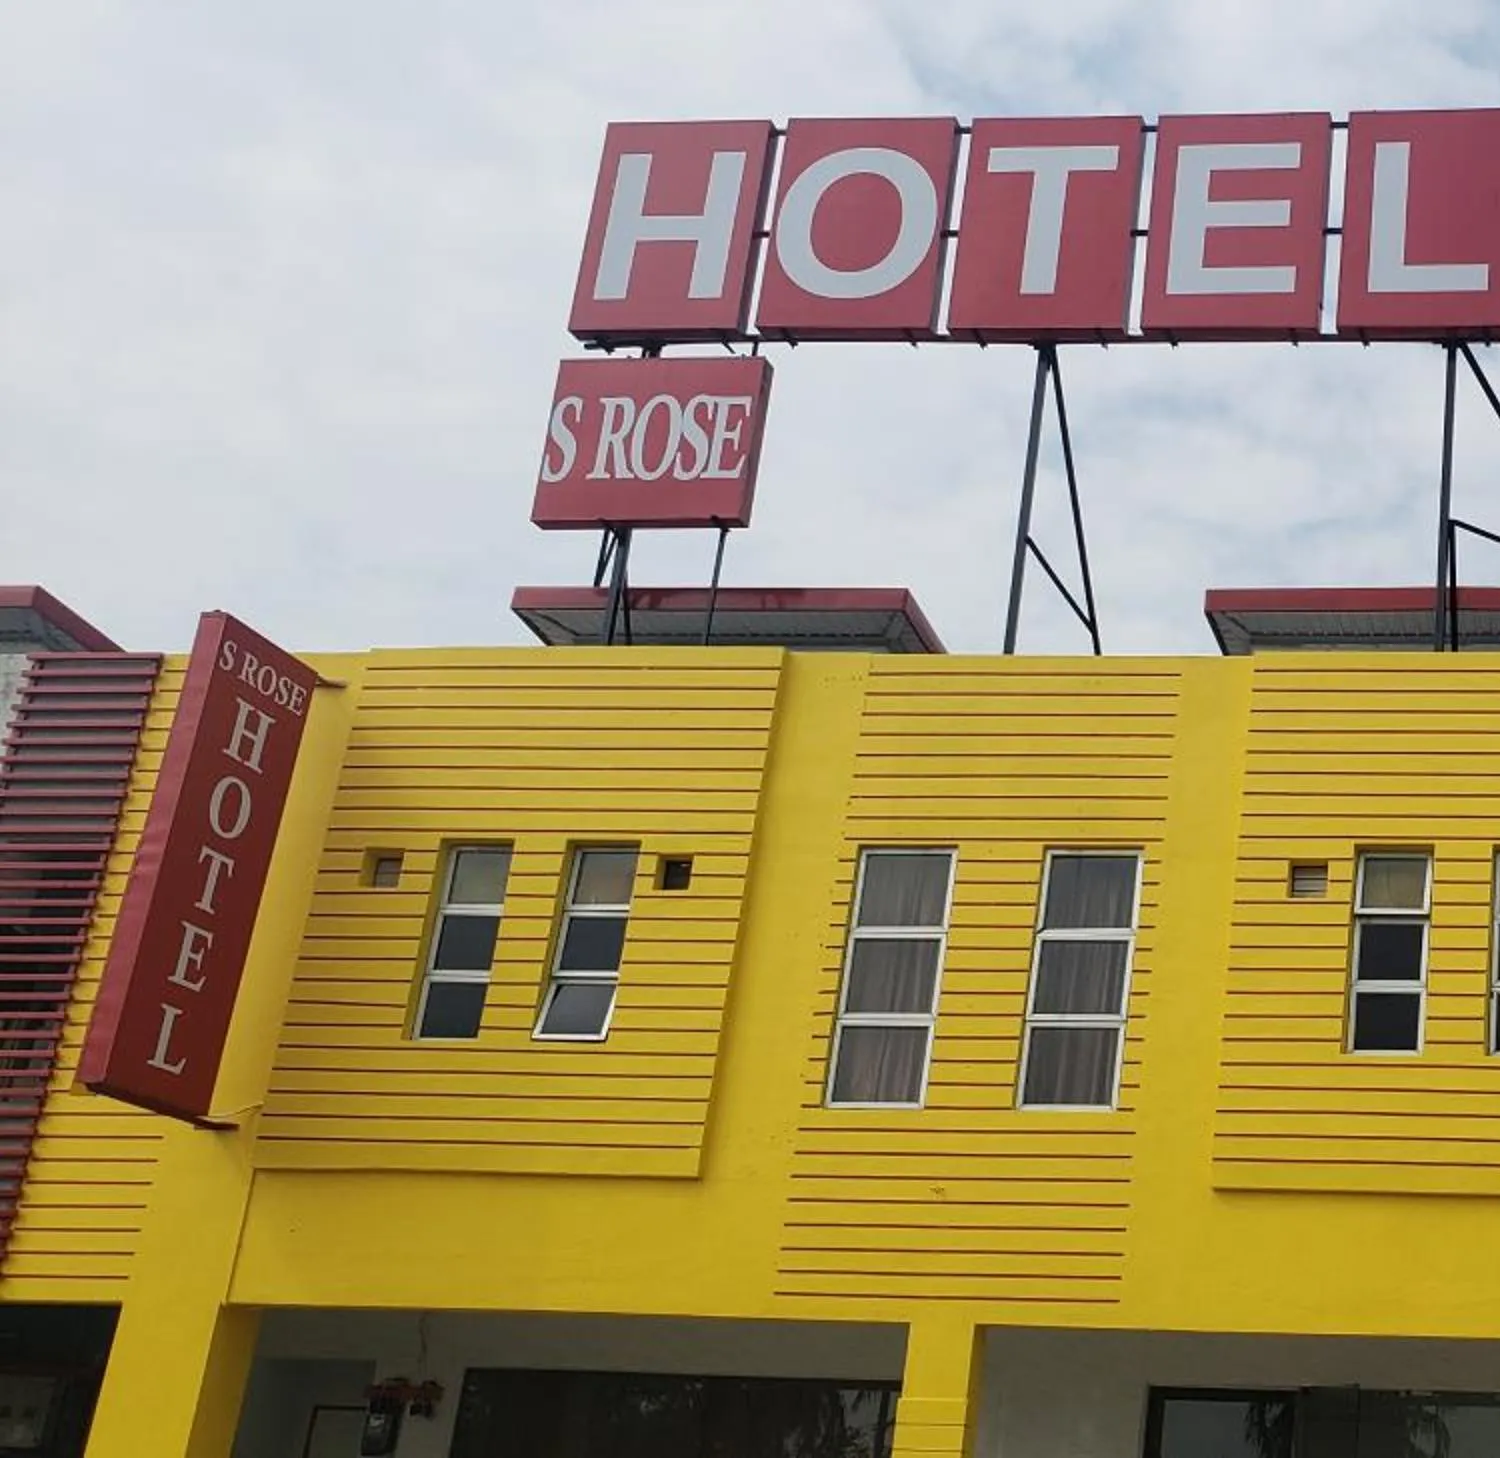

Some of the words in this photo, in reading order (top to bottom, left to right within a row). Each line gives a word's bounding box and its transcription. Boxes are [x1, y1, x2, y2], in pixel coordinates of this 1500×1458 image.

[592, 141, 1489, 300] HOTEL
[543, 396, 584, 483] S
[587, 394, 753, 481] ROSE
[219, 641, 237, 671] S
[238, 653, 308, 717] ROSE
[147, 698, 276, 1074] HOTEL
